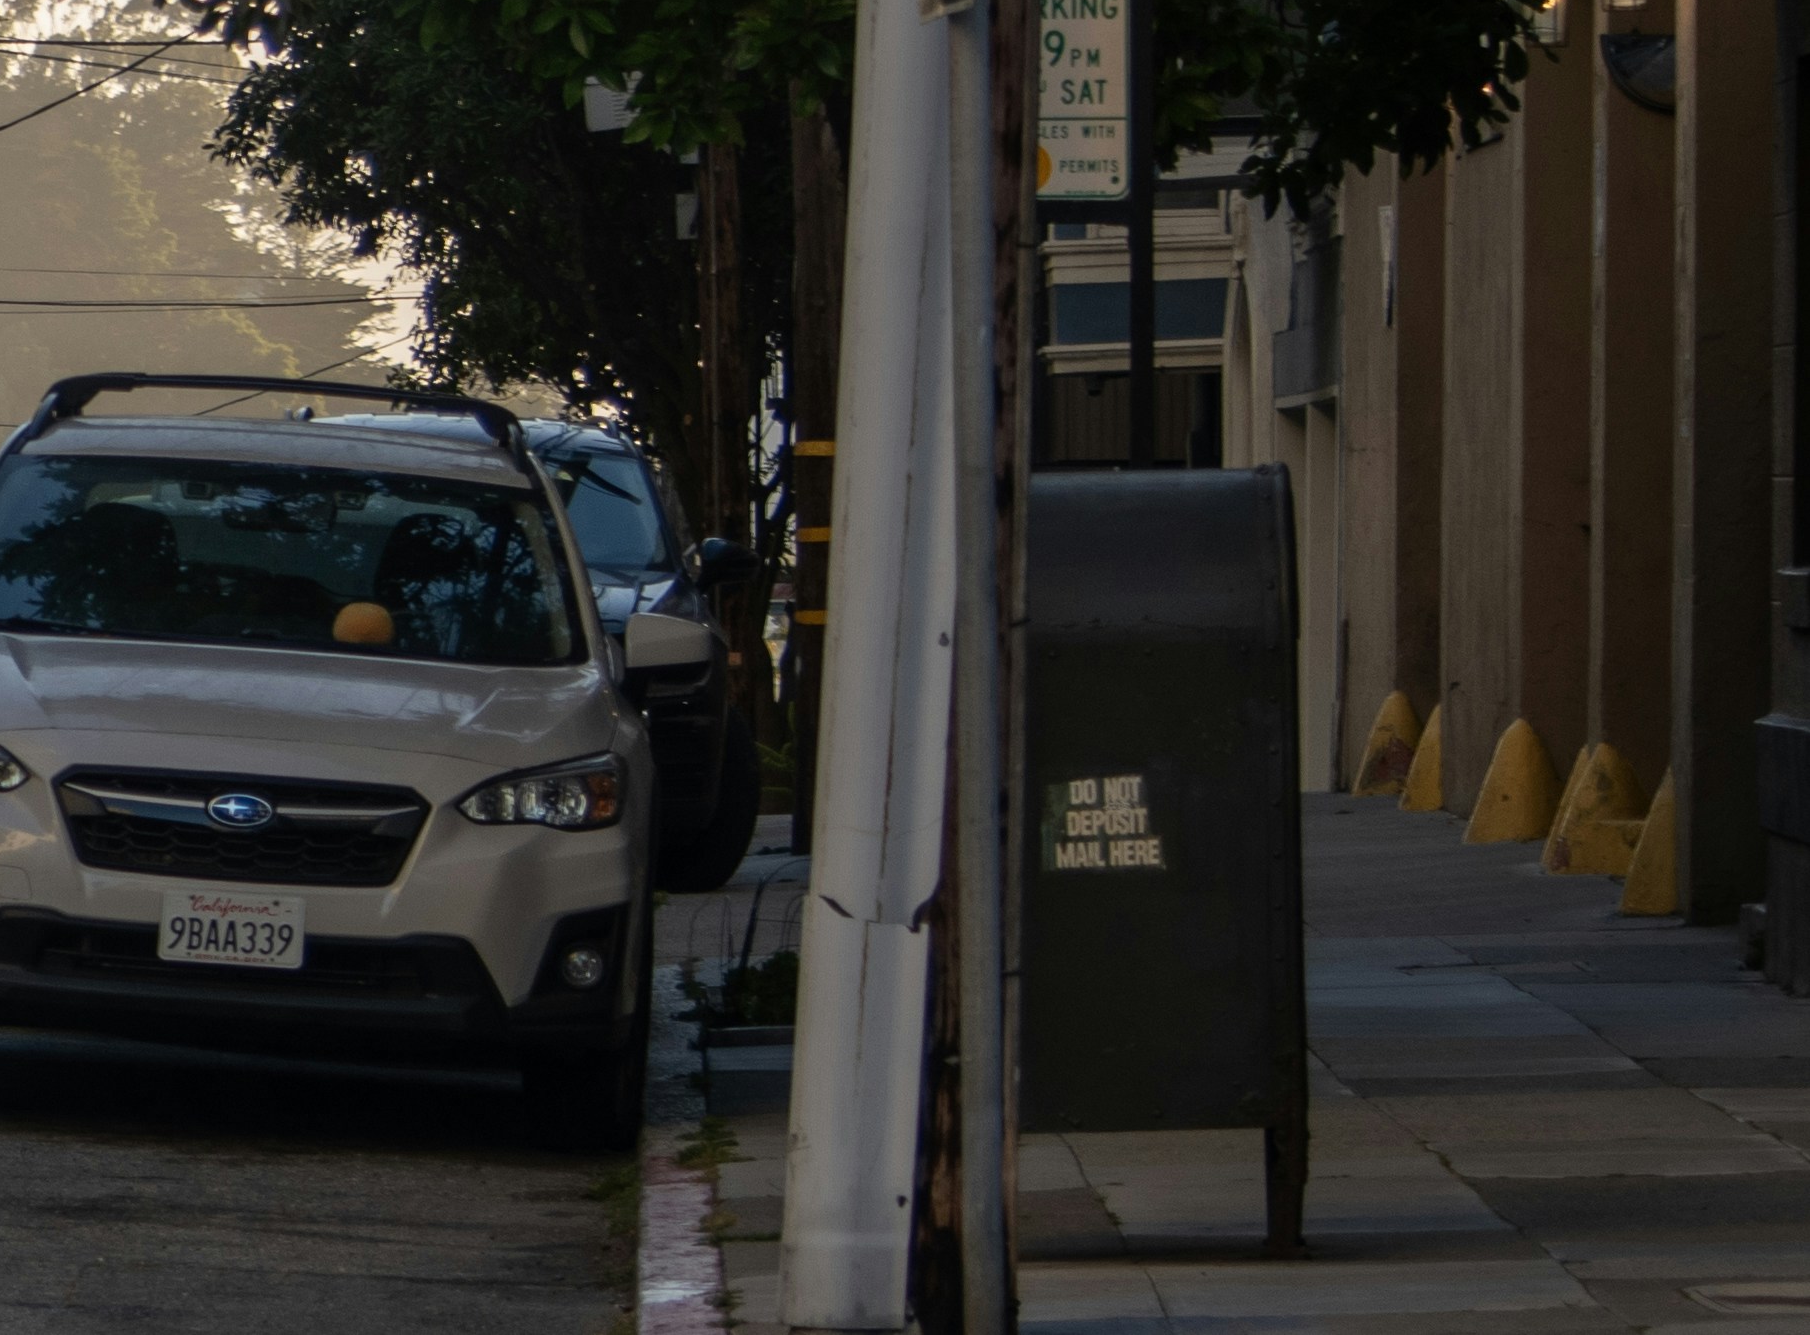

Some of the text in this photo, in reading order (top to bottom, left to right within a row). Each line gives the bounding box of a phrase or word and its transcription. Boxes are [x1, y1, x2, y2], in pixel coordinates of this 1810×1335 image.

[1044, 30, 1100, 67] 9 PM
[1061, 79, 1108, 105] SAT
[1082, 126, 1115, 139] WITH
[1059, 160, 1119, 173] PERMITS
[1069, 776, 1142, 805] DO NOT
[1066, 808, 1148, 837] DEPOSIT
[1056, 838, 1161, 868] MAIL HERE
[190, 895, 279, 918] California
[167, 916, 294, 957] 9BAA339
